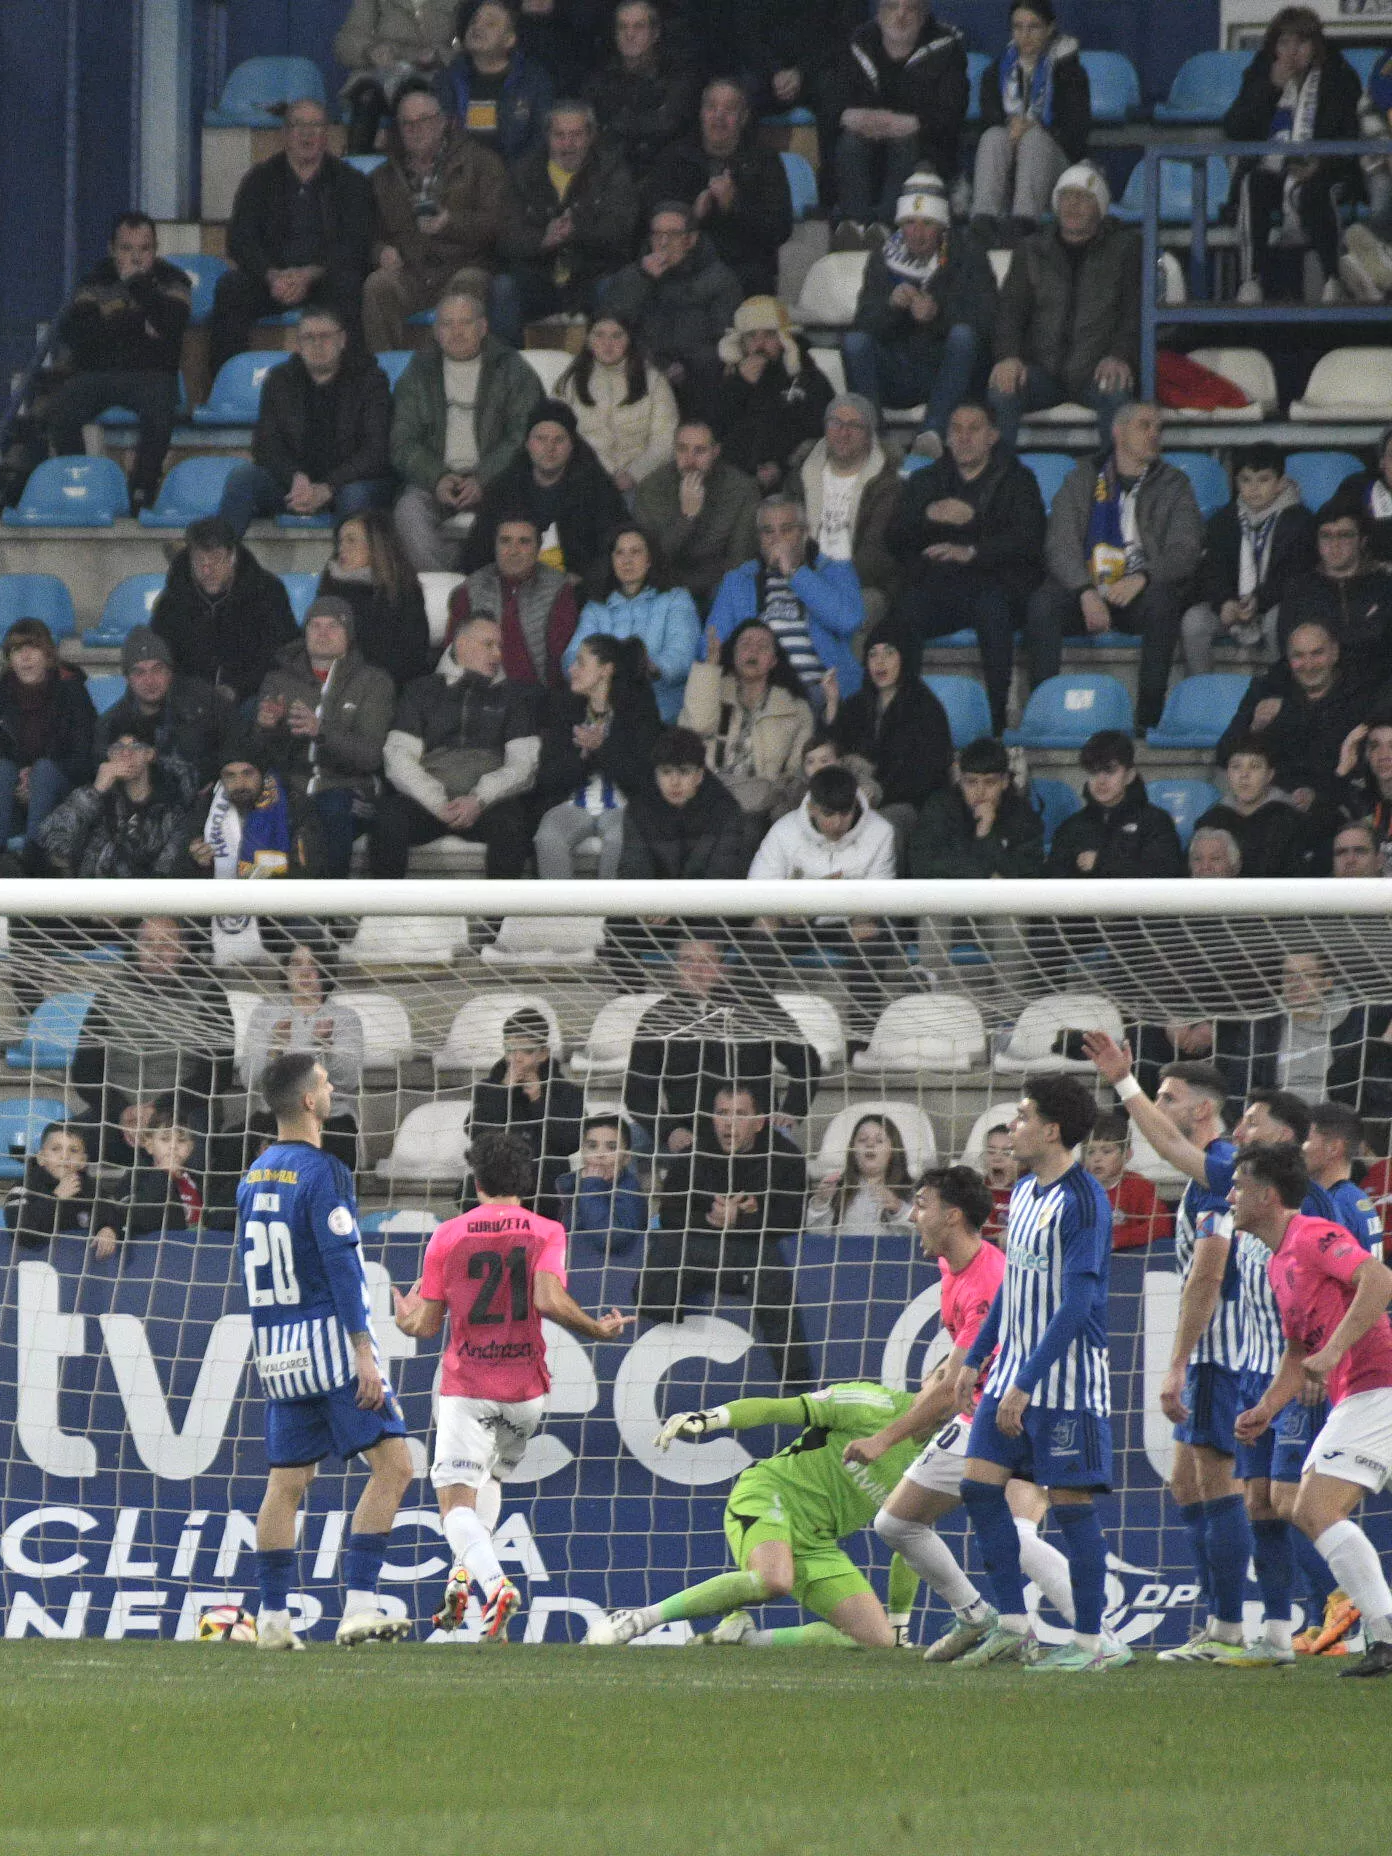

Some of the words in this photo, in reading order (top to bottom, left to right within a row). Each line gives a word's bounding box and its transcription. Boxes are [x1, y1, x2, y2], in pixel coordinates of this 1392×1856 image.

[244, 1221, 301, 1307] 20
[467, 1247, 529, 1325] 21
[1132, 1584, 1201, 1608] DP
